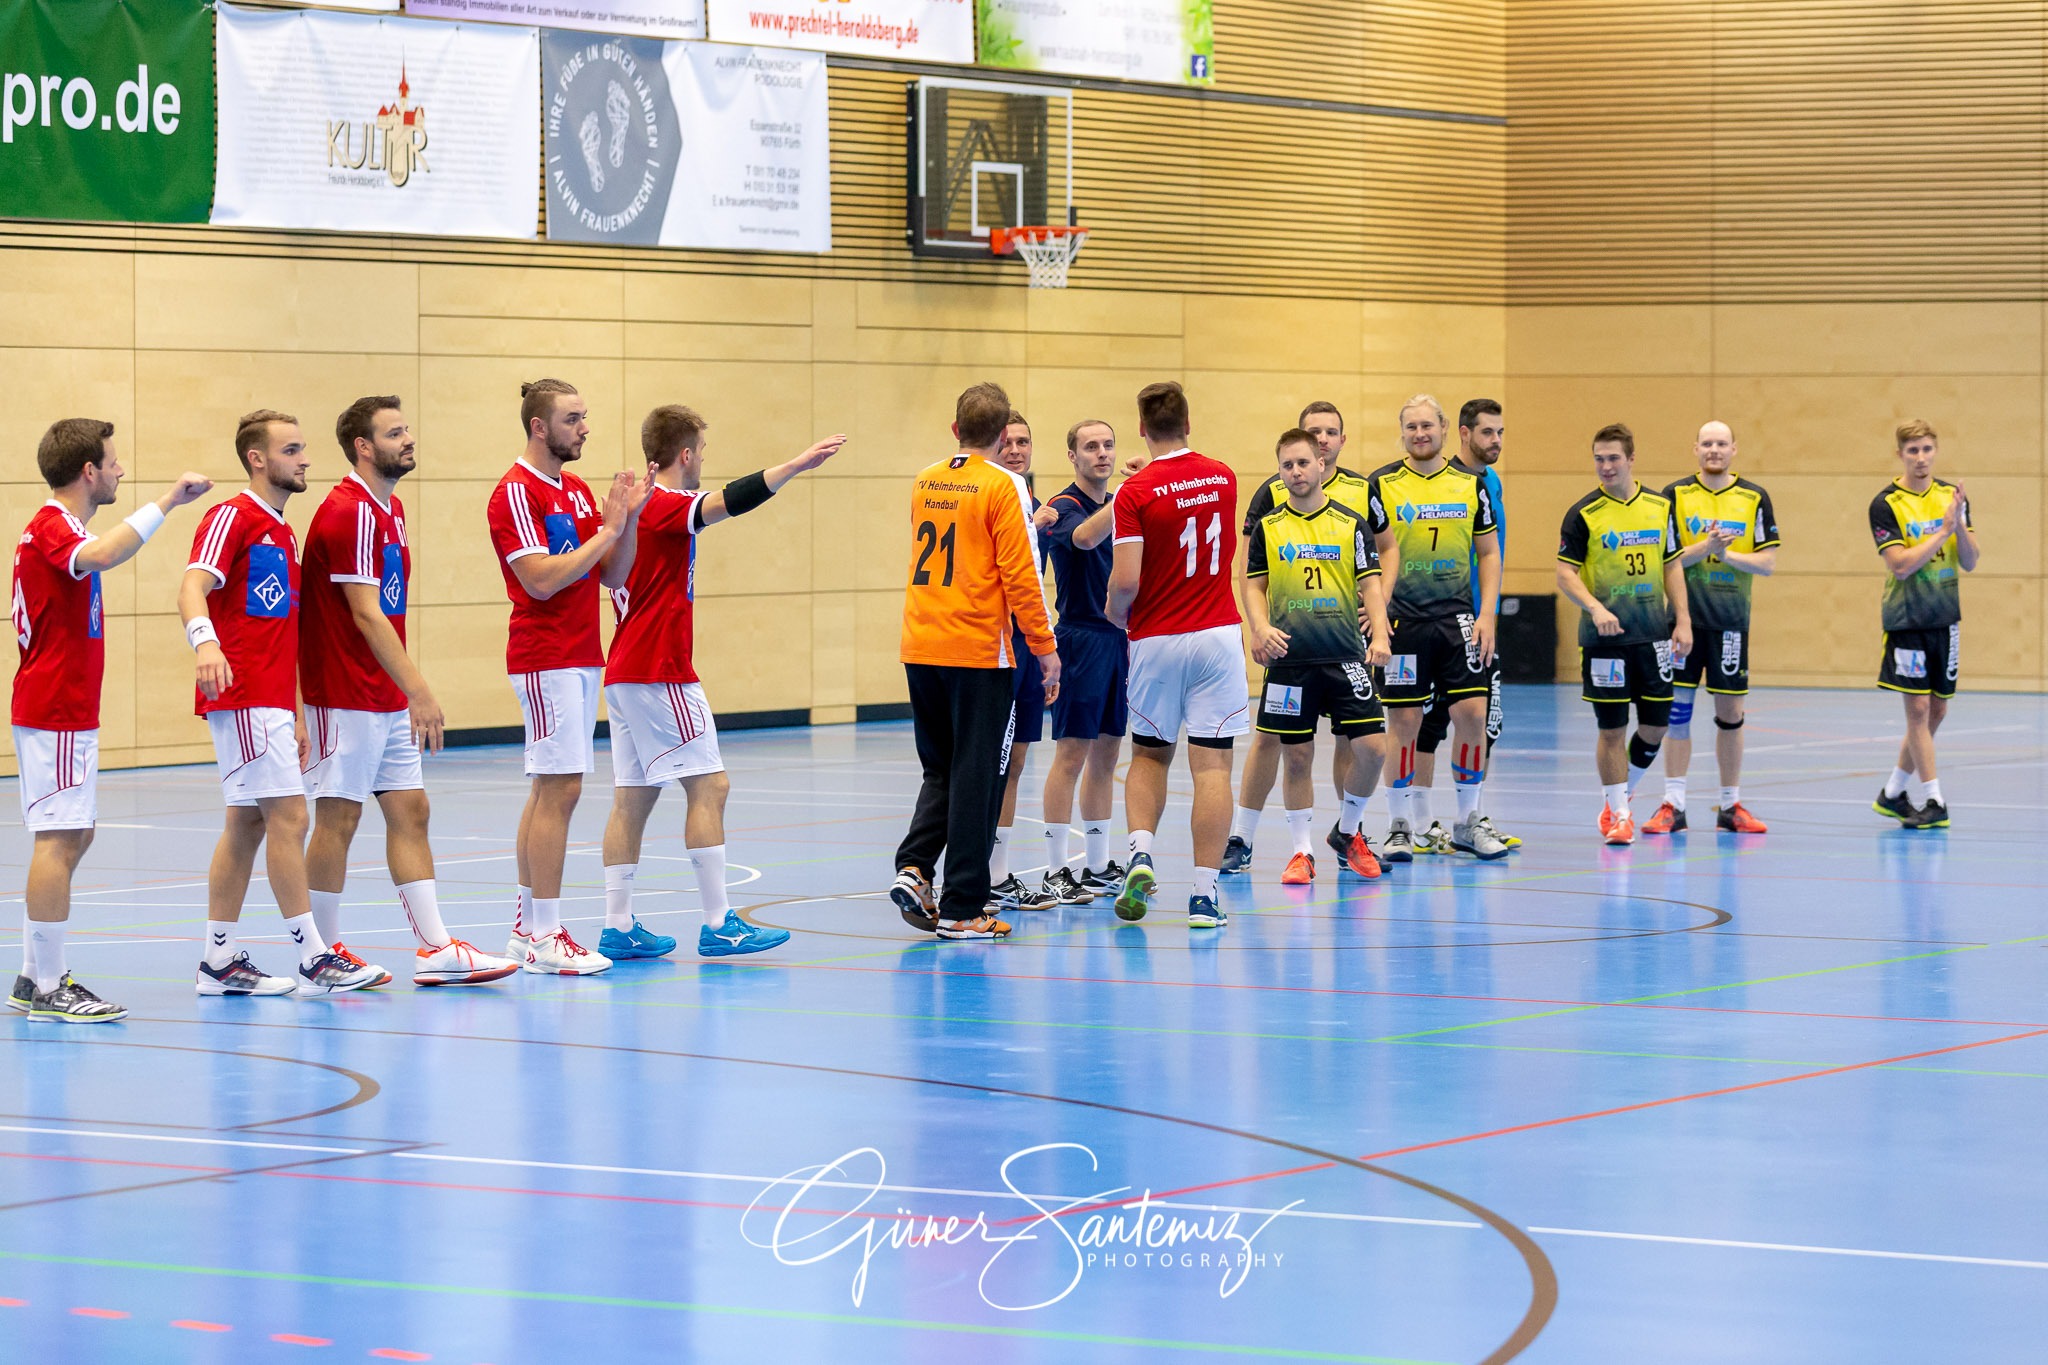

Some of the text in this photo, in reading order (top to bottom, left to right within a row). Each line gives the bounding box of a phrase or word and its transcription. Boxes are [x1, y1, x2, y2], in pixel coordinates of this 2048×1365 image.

[469, 0, 509, 11] Immobilien
[510, 5, 524, 13] aller
[527, 6, 537, 15] Art
[554, 8, 579, 18] Verkauf
[581, 11, 595, 19] oder
[598, 13, 608, 21] zur
[610, 13, 647, 26] Vermietung
[749, 8, 918, 49] www.prechtel-heroldsberg.de
[2, 64, 181, 143] pro.de
[549, 92, 567, 138] IHRE
[586, 43, 599, 62] IN
[633, 75, 658, 148] HÄNDEN
[326, 119, 430, 187] KULTUR
[553, 169, 656, 233] ALVIN FRAUENKNECHT
[928, 480, 979, 493] Helmbrechts
[1153, 475, 1229, 497] TV Helmbrechts
[567, 490, 593, 519] 24
[924, 498, 959, 510] Handball
[1176, 491, 1220, 509] Handball
[1421, 510, 1467, 519] HELMREICH
[1179, 512, 1222, 578] 11
[1300, 544, 1316, 552] SALZ
[1428, 526, 1439, 551] 7
[911, 520, 956, 587] 21
[1301, 551, 1339, 560] HELMREICH
[1625, 552, 1646, 576] 33
[1303, 566, 1322, 590] 21
[1405, 558, 1456, 575] psyma
[1288, 597, 1337, 613] psyma
[1487, 680, 1502, 732] MEIER
